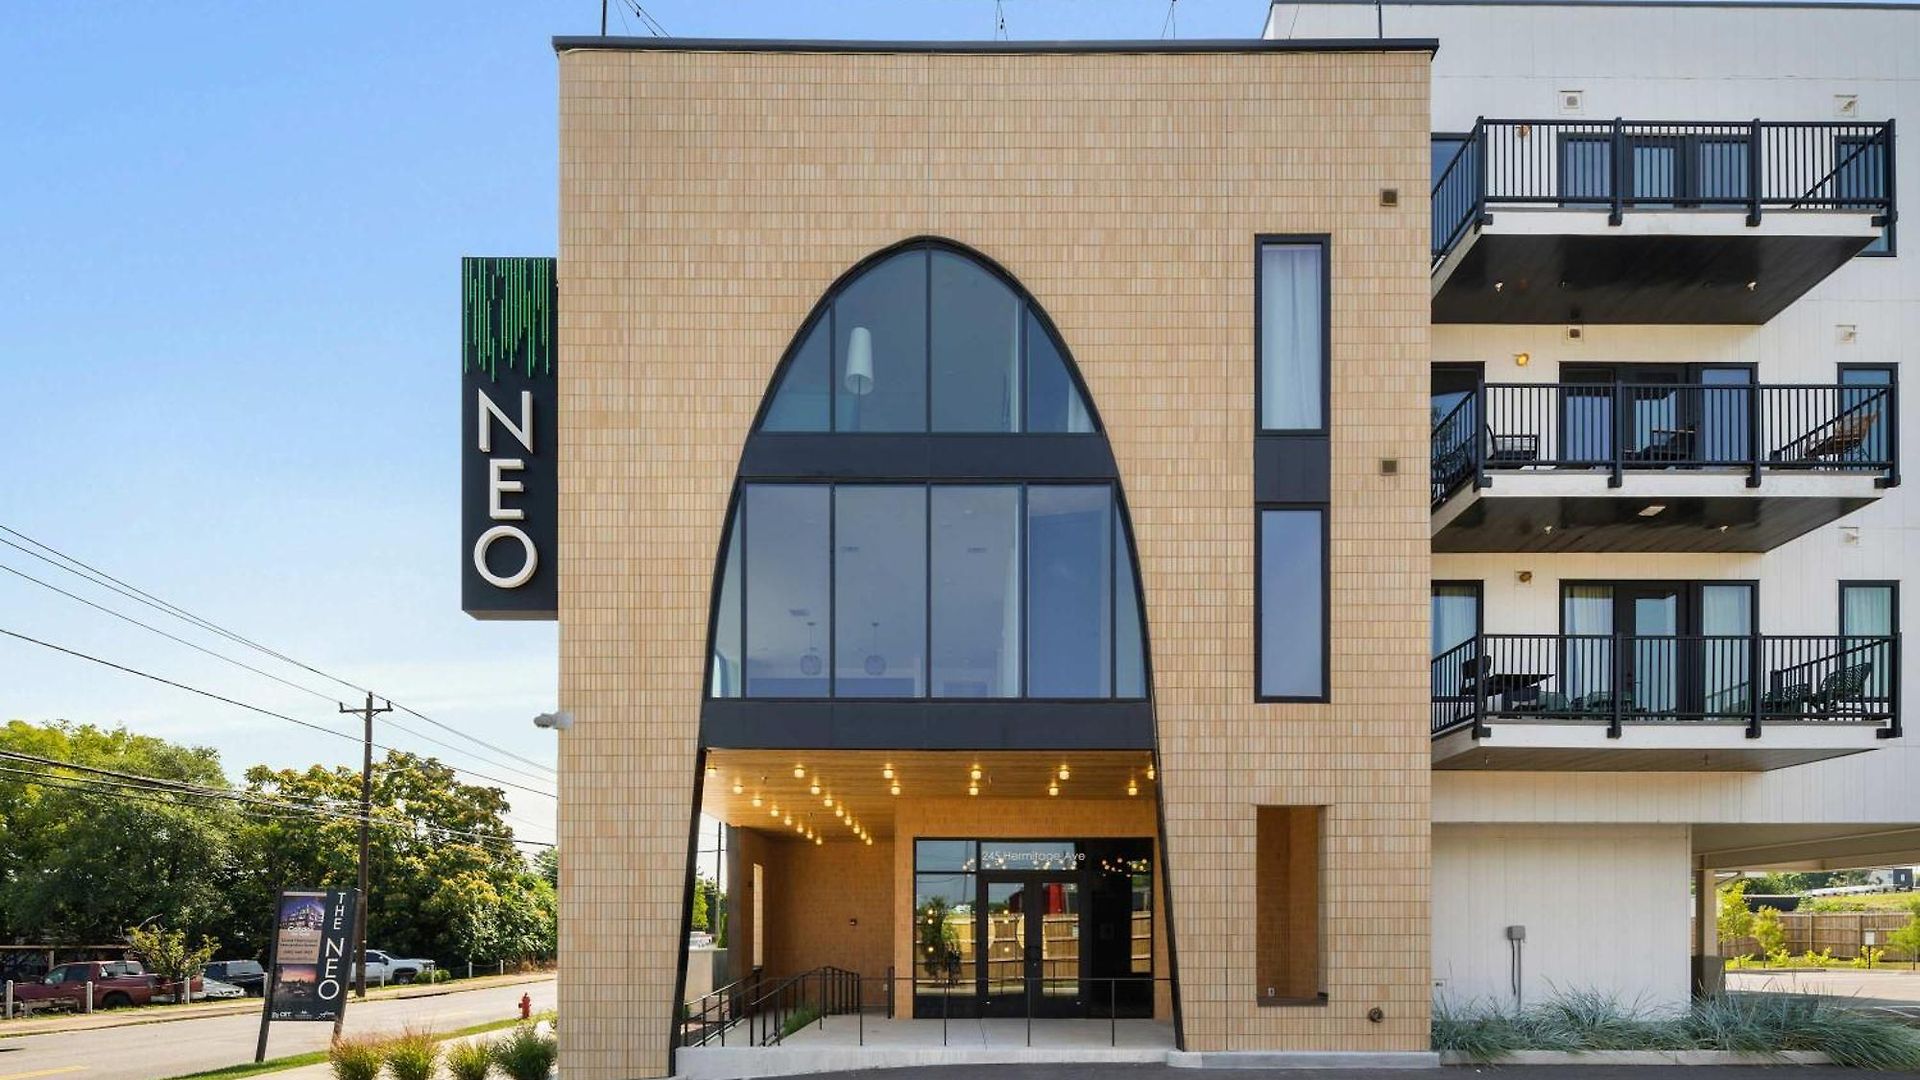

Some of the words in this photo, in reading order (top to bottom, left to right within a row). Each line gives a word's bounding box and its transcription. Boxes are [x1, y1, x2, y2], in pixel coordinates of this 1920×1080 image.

[474, 387, 539, 589] NEO
[983, 852, 1001, 861] 245
[1004, 851, 1061, 863] Hermitage
[1064, 852, 1086, 861] Ave
[333, 892, 346, 930] THE
[318, 937, 345, 1000] NEO
